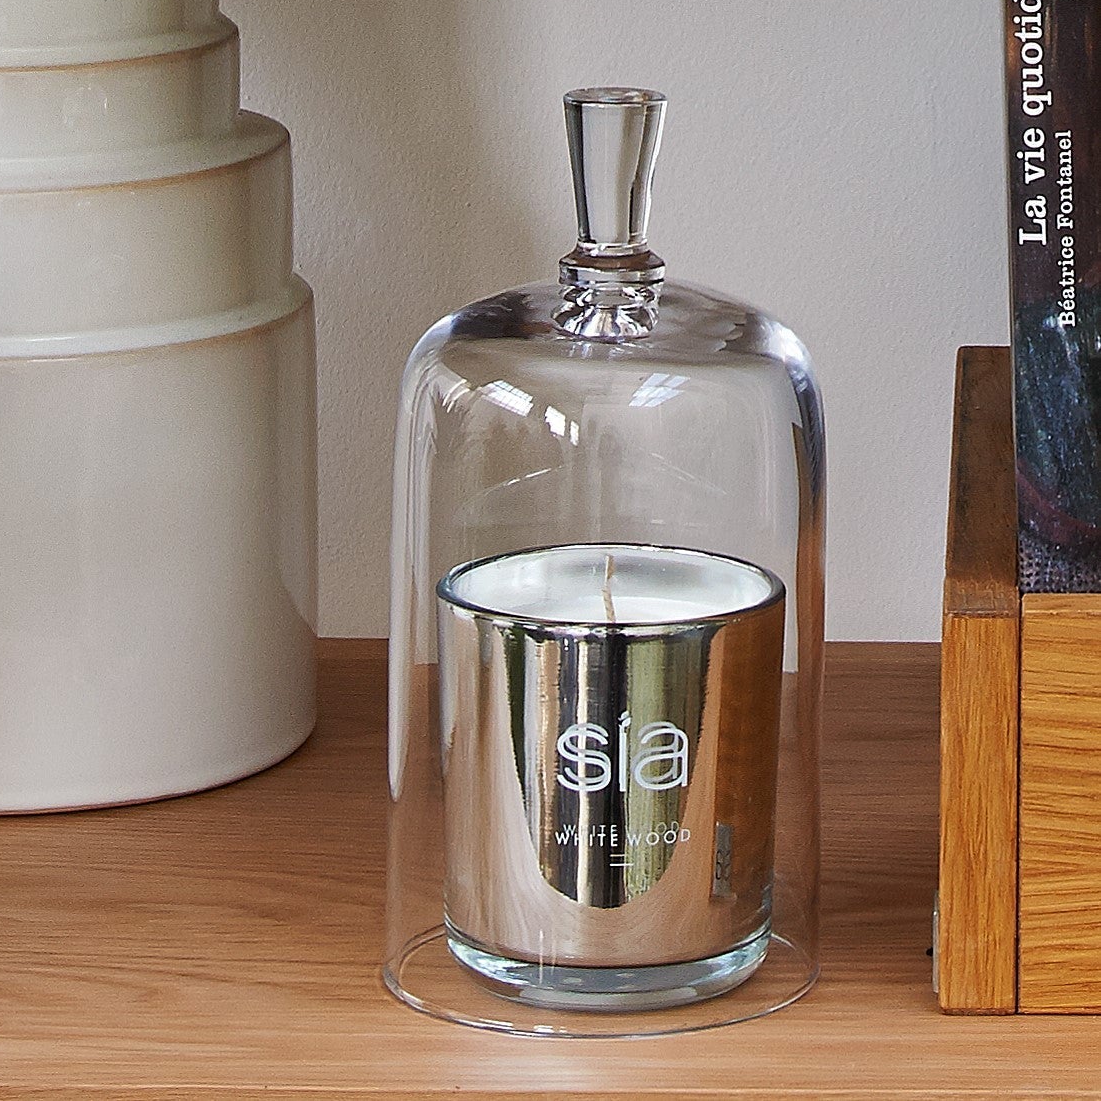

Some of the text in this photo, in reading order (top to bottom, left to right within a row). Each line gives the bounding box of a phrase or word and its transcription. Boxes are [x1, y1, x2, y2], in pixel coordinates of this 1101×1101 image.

[1017, 127, 1047, 185] vie
[1019, 195, 1048, 246] La
[1054, 129, 1076, 328] Béatrice Fontanel
[555, 828, 692, 848] WHITE WOOD
